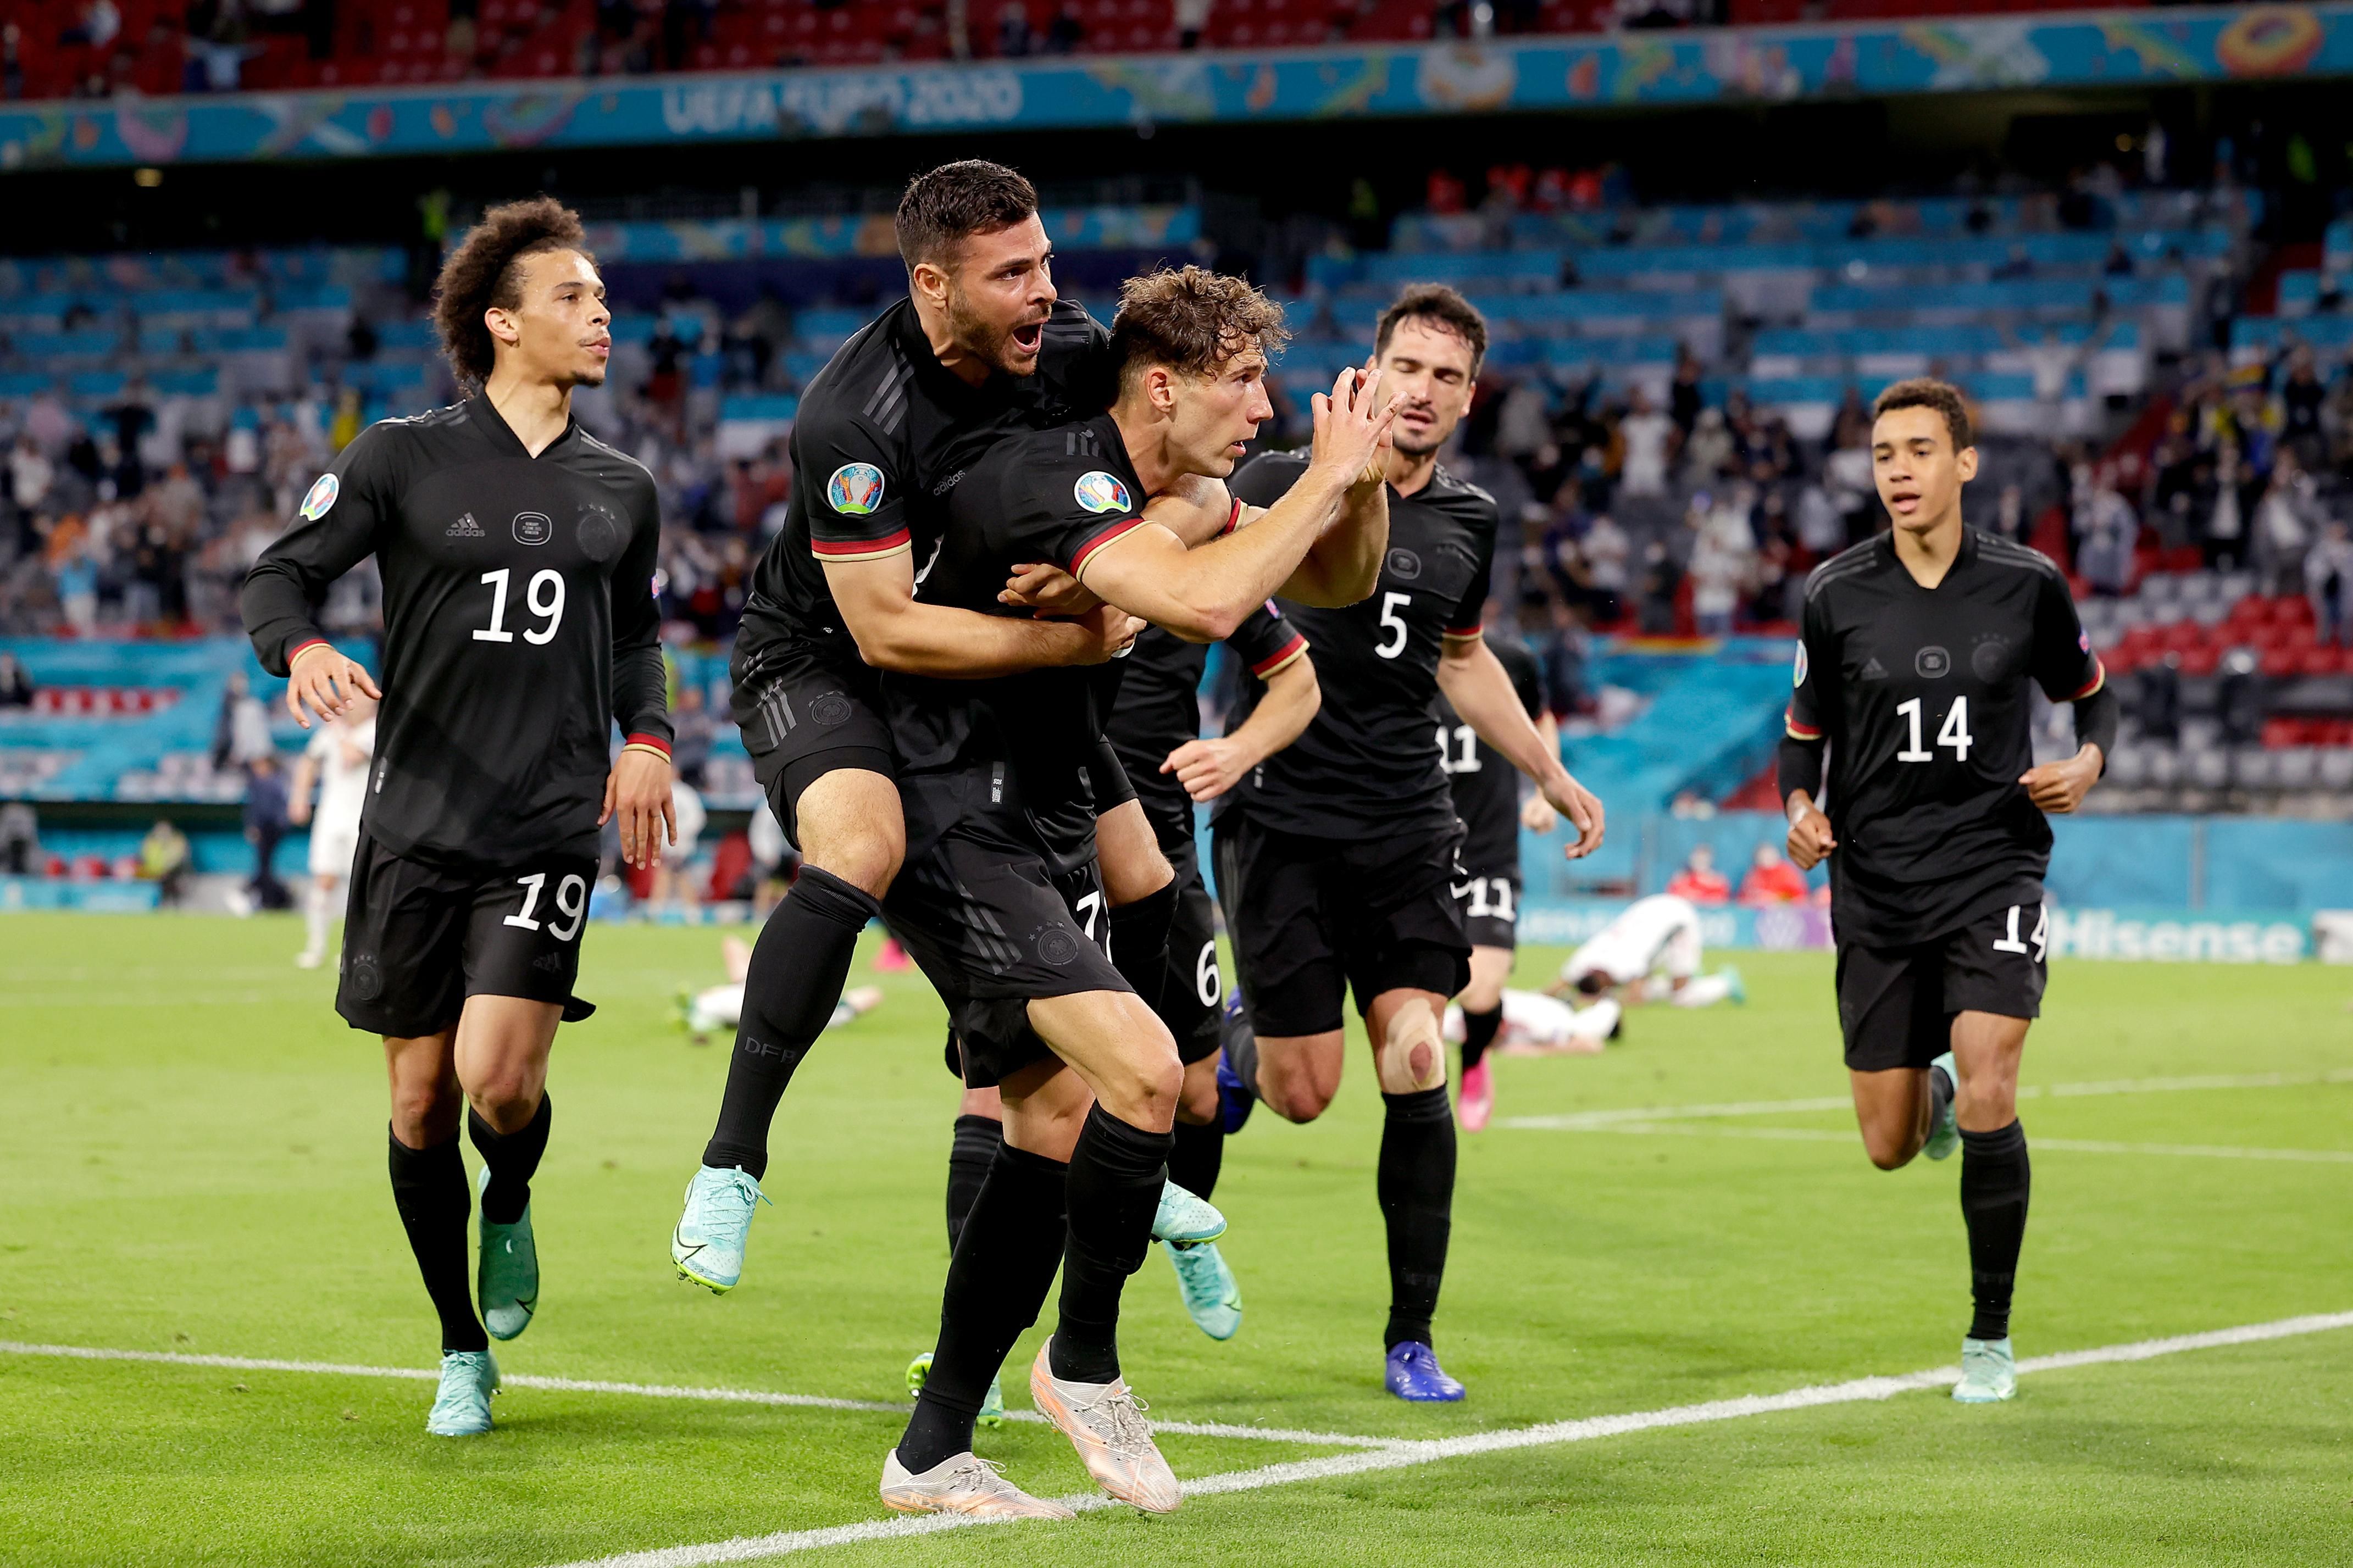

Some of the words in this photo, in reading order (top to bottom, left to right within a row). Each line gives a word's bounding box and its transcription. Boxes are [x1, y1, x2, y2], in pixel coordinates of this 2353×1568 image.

[663, 84, 776, 135] UEFA
[907, 69, 1023, 124] 2020
[933, 470, 966, 496] adidas
[445, 527, 486, 537] adidas
[472, 568, 565, 646] 19
[1374, 591, 1412, 659] 5
[1435, 724, 1483, 774] 11
[1896, 694, 1973, 763] 14
[502, 872, 586, 942] 19
[1466, 876, 1517, 923] 11
[1991, 902, 2050, 964] 14
[2047, 908, 2305, 963] Hisense
[1196, 939, 1222, 1008] 6
[744, 1036, 796, 1064] DFB
